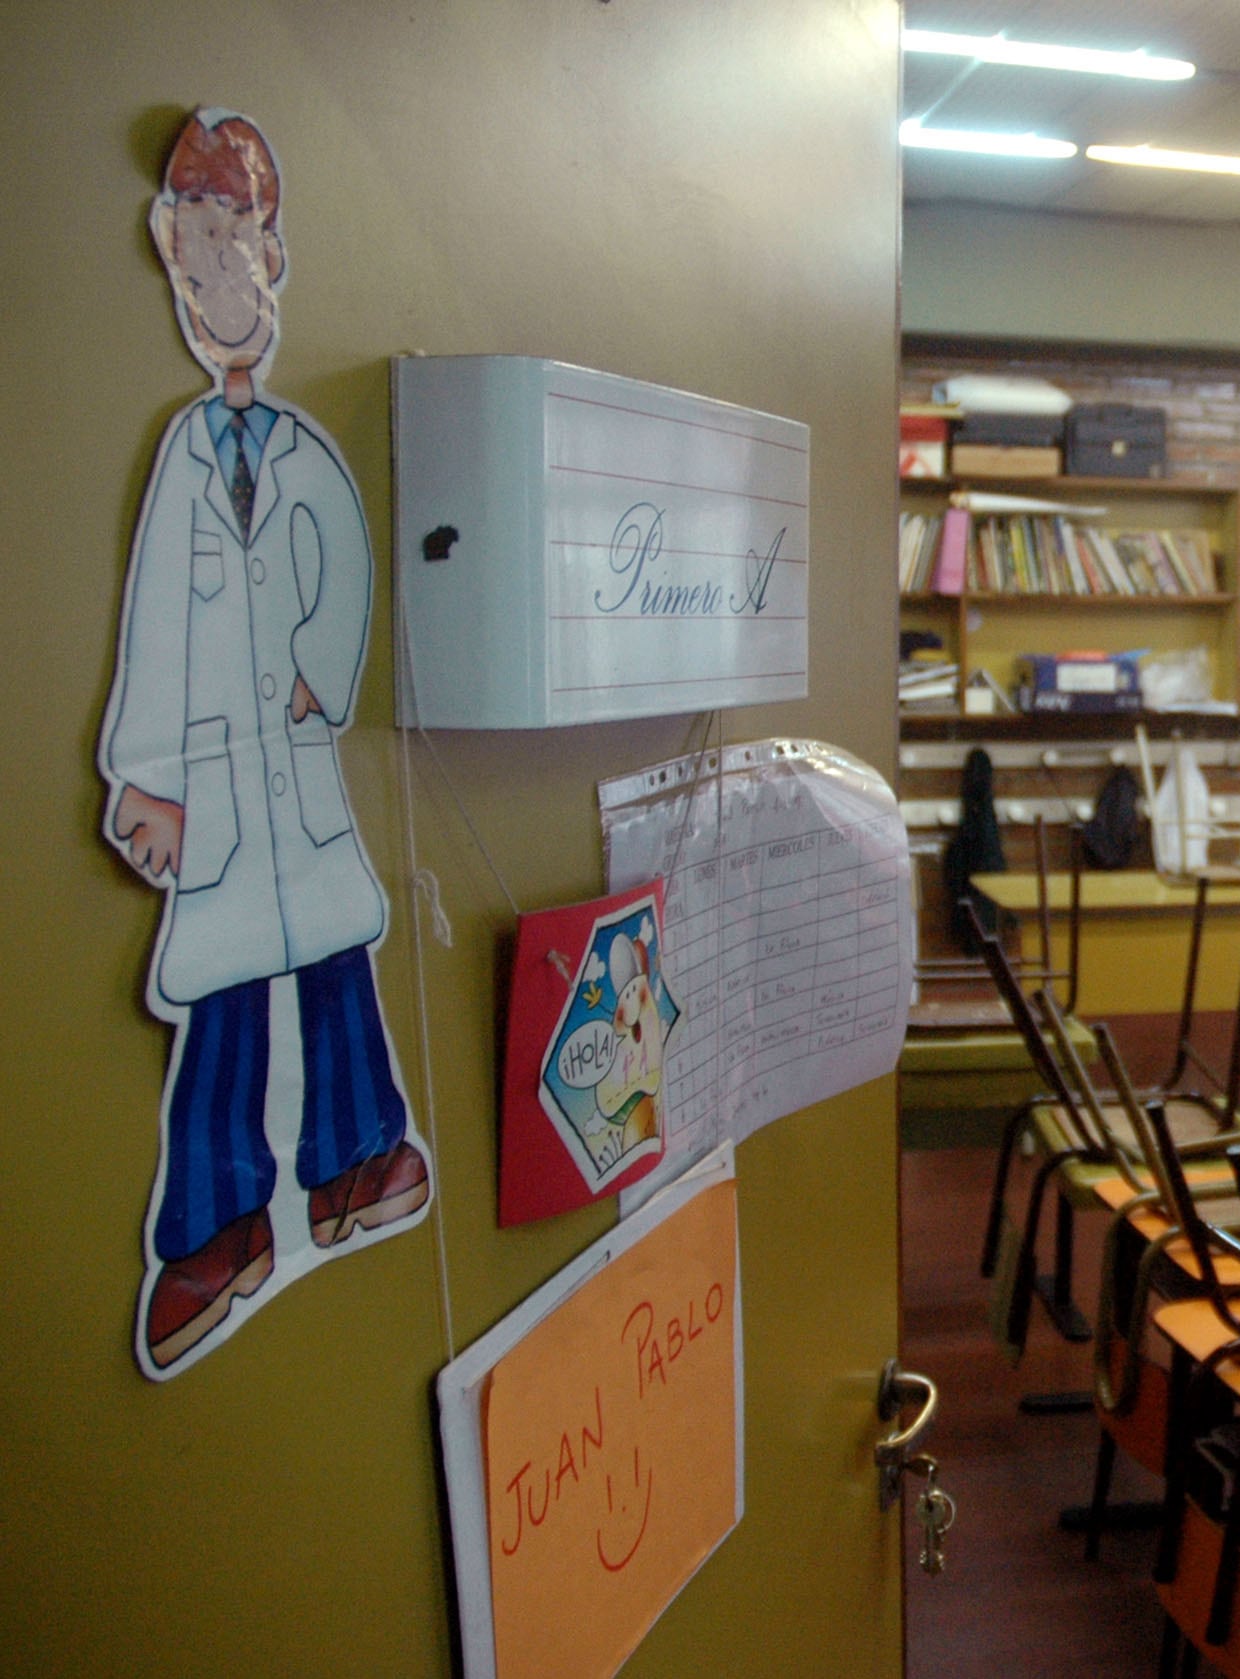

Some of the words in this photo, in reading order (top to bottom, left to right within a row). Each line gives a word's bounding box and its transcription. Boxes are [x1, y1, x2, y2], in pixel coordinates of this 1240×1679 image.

[594, 502, 723, 615] Primero
[729, 526, 788, 614] A
[562, 1028, 615, 1080] ¡HOLA!
[501, 1386, 603, 1556] JUAN
[620, 1282, 724, 1400] PABLO
